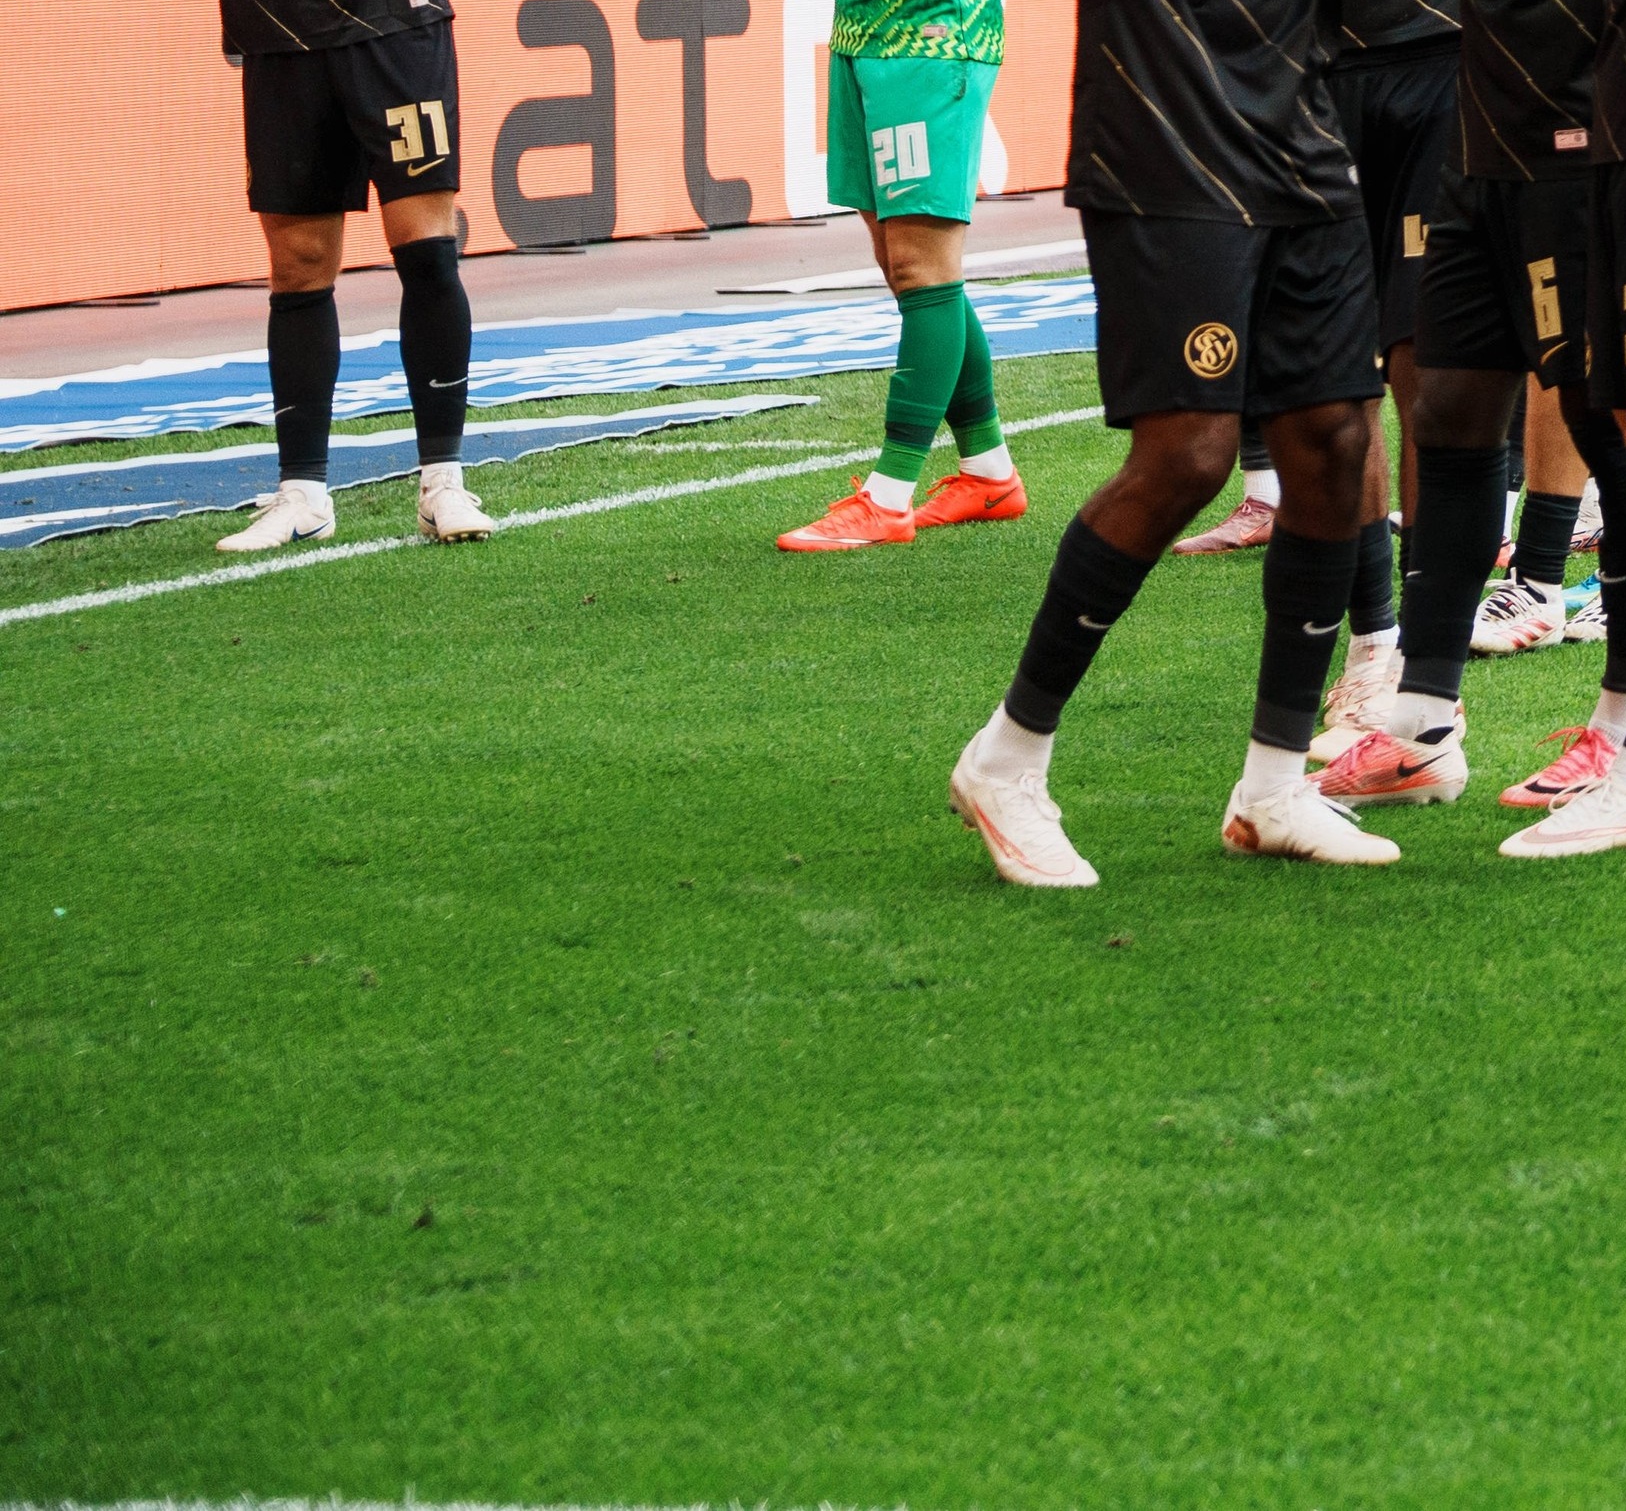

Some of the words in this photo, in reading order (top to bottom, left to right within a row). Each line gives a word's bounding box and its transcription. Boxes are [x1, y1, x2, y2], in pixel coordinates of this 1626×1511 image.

[385, 100, 450, 162] 31
[871, 121, 931, 187] 20
[1527, 256, 1564, 341] 6
